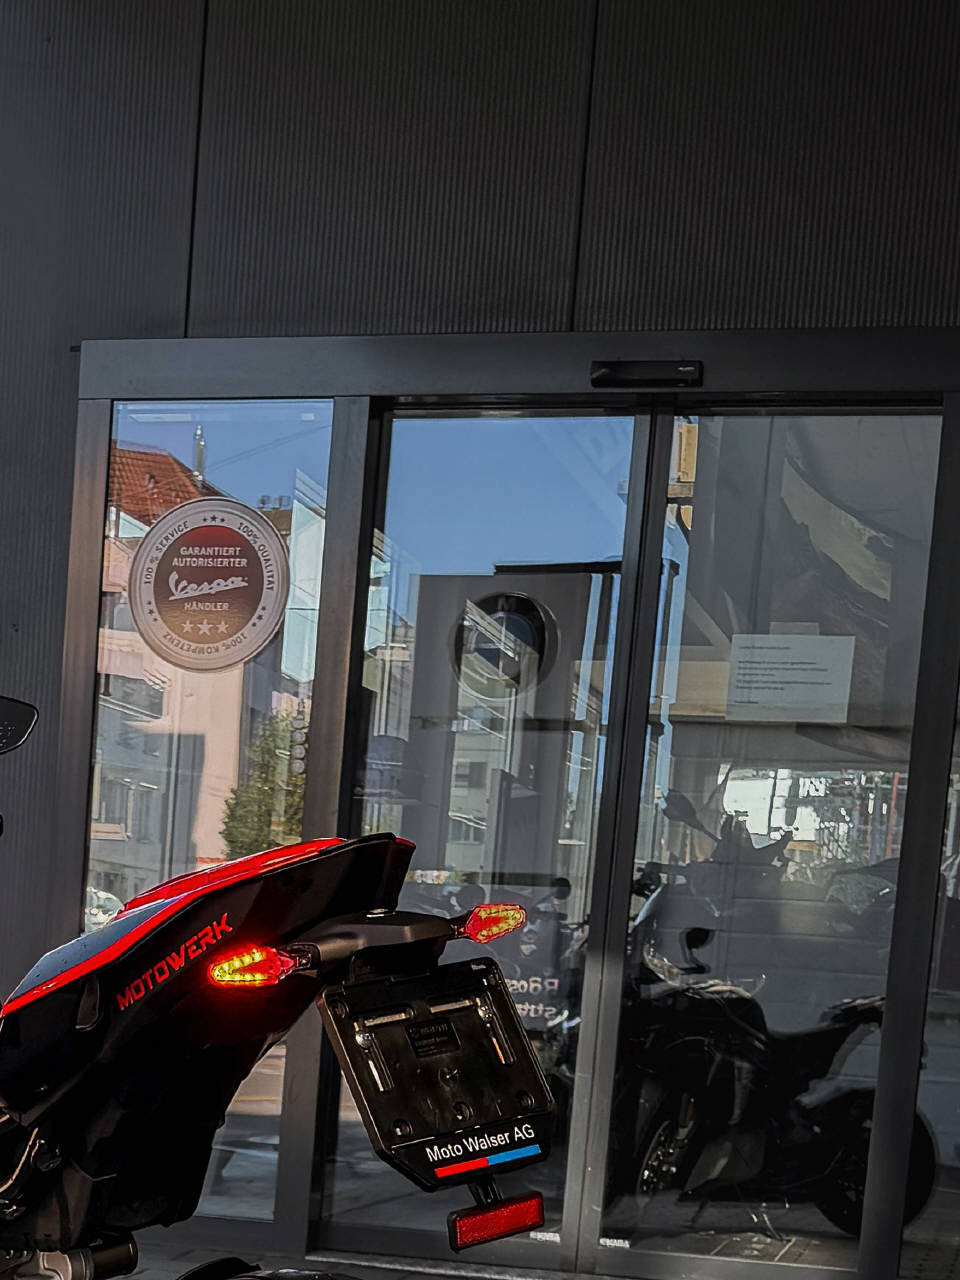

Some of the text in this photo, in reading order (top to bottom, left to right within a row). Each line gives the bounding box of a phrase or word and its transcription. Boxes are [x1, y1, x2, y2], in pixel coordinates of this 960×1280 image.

[155, 520, 189, 553] SERVICE
[180, 546, 241, 556] GARANTIERT
[172, 557, 248, 568] AUTORISIERTER
[168, 570, 249, 601] Vespa
[116, 912, 233, 1011] MOTOWERK
[425, 1123, 535, 1162] Moto Walser AG
